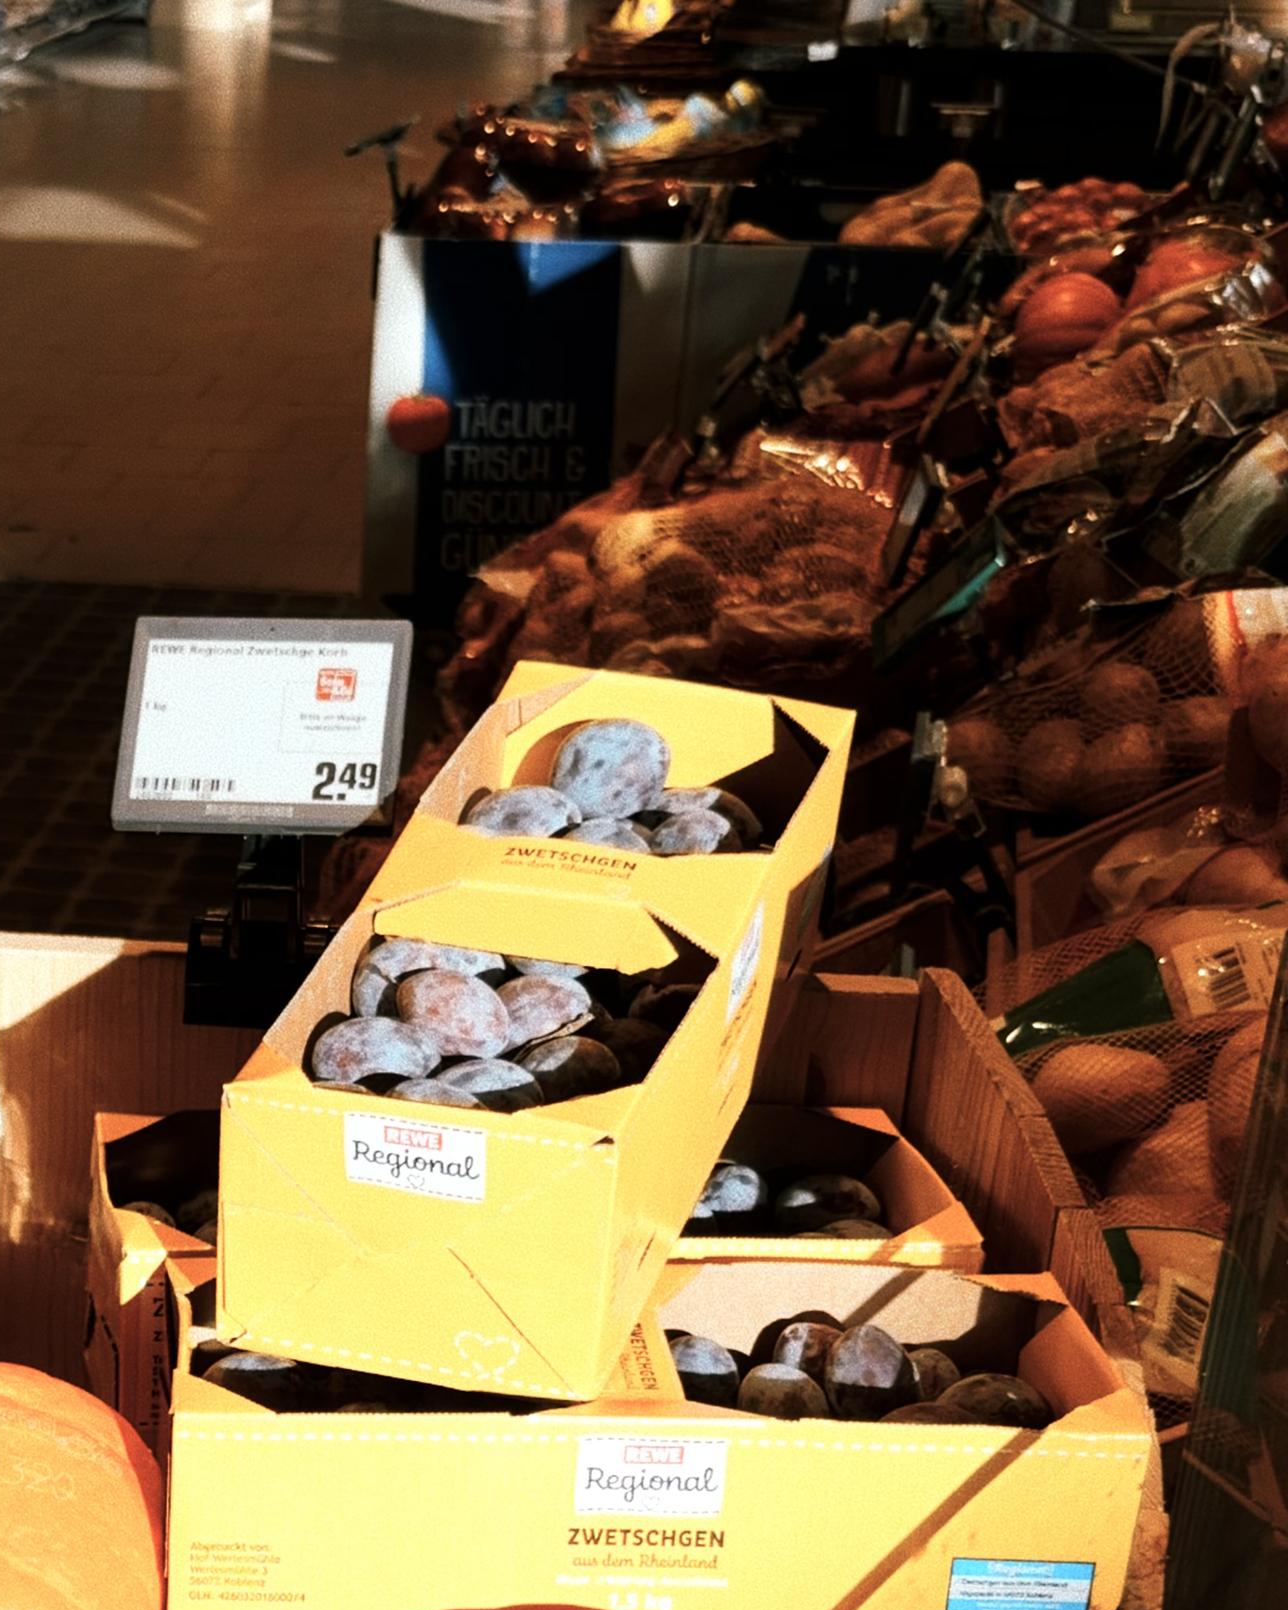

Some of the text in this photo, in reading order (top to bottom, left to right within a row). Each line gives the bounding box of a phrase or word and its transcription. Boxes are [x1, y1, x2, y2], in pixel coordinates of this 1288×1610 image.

[455, 396, 576, 440] TÄGLICH
[443, 444, 586, 483] FRISCH &
[189, 646, 244, 659] Regional
[311, 762, 377, 801] 2.49
[504, 846, 637, 872] ZWETSCHGEN
[385, 1127, 442, 1150] REWE
[352, 1139, 481, 1181] Regional
[624, 1446, 684, 1465] REWE
[584, 1466, 719, 1503] Regional
[567, 1527, 725, 1549] ZWETSCHGEN
[572, 1553, 718, 1570] aus dem Rheinland
